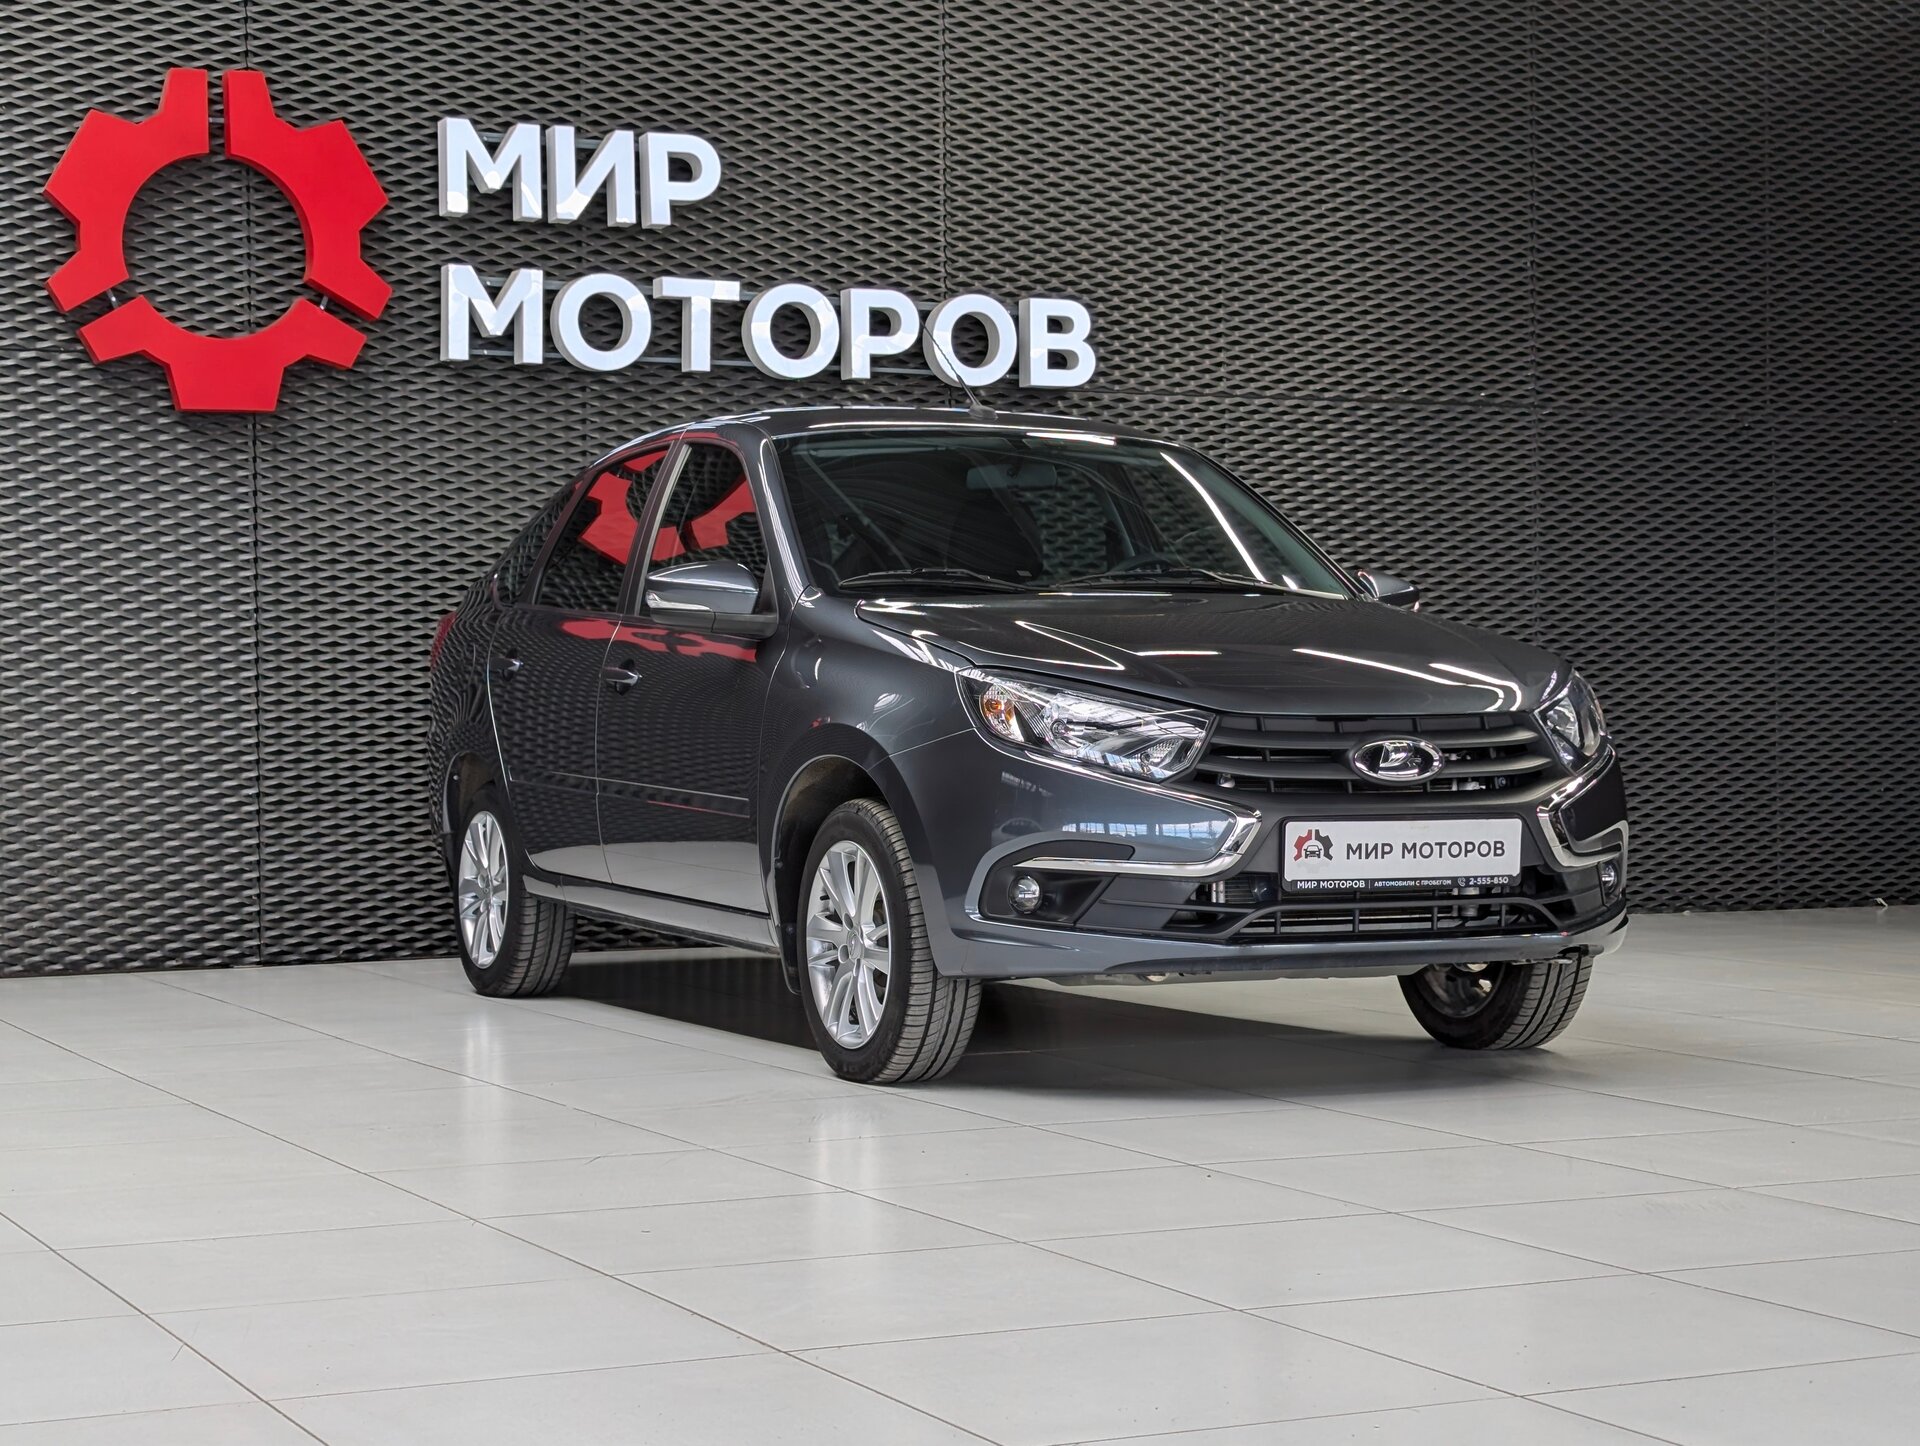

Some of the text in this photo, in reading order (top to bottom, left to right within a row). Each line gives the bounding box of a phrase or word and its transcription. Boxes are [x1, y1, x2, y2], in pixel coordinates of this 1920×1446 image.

[437, 117, 722, 229] МИР
[440, 263, 1097, 388] МОТОРОВ
[1297, 880, 1318, 889] МИР
[1320, 880, 1366, 889] МОТОРОВ
[1374, 880, 1415, 888] АВТОМОБИЛИ
[1469, 876, 1509, 885] 2-555-850
[1346, 840, 1506, 860] МИР МОТОРОВ
